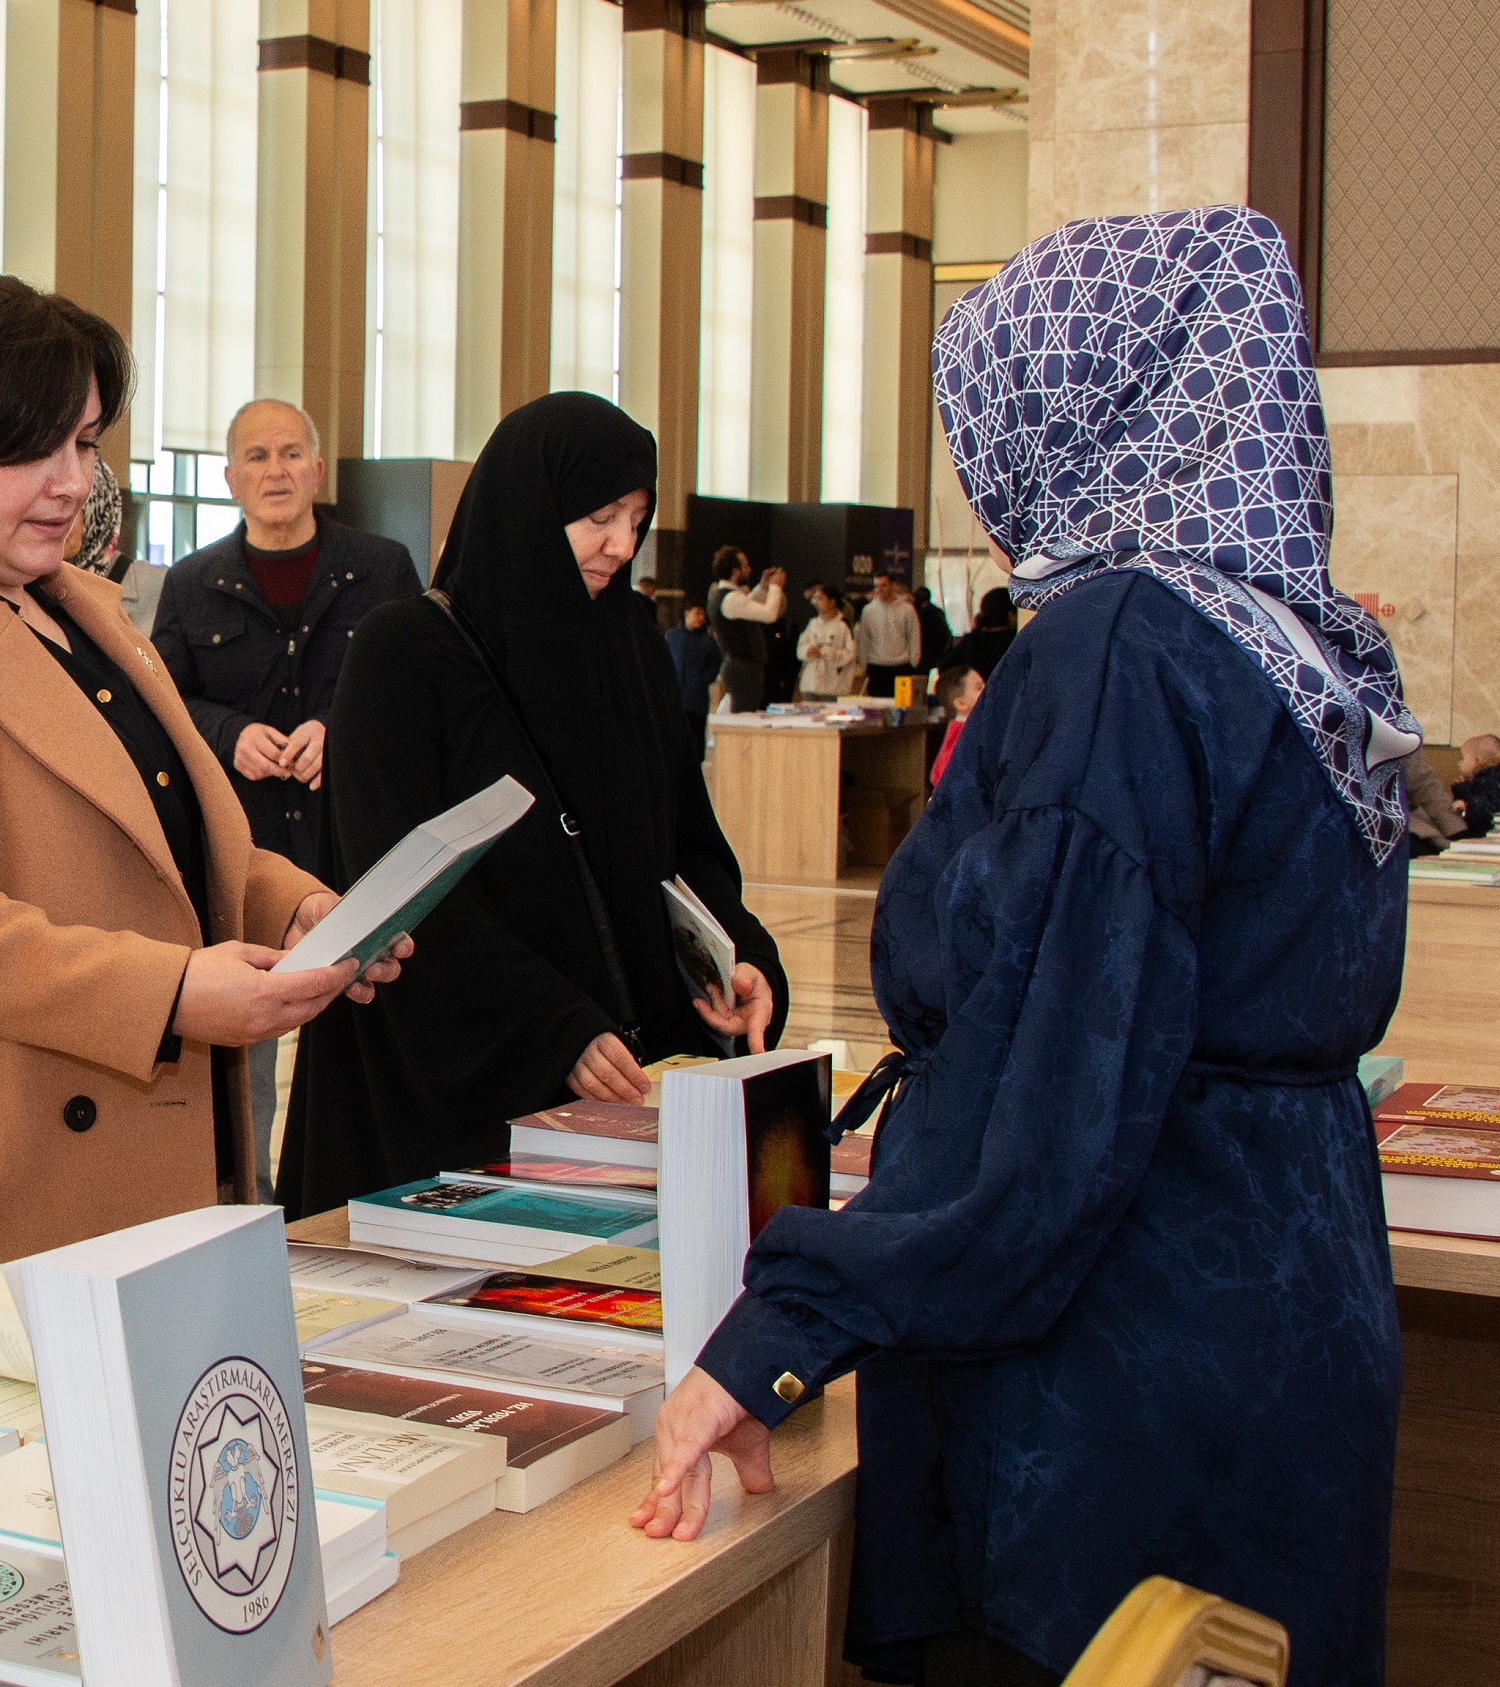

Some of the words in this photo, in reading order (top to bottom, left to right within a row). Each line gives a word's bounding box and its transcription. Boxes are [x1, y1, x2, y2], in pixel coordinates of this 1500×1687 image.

[182, 1367, 276, 1444] ARAŞTIRMALARI
[273, 1411, 296, 1523] MERKEZİ
[173, 1451, 202, 1587] SELÇUKLU
[243, 1590, 269, 1623] 1986
